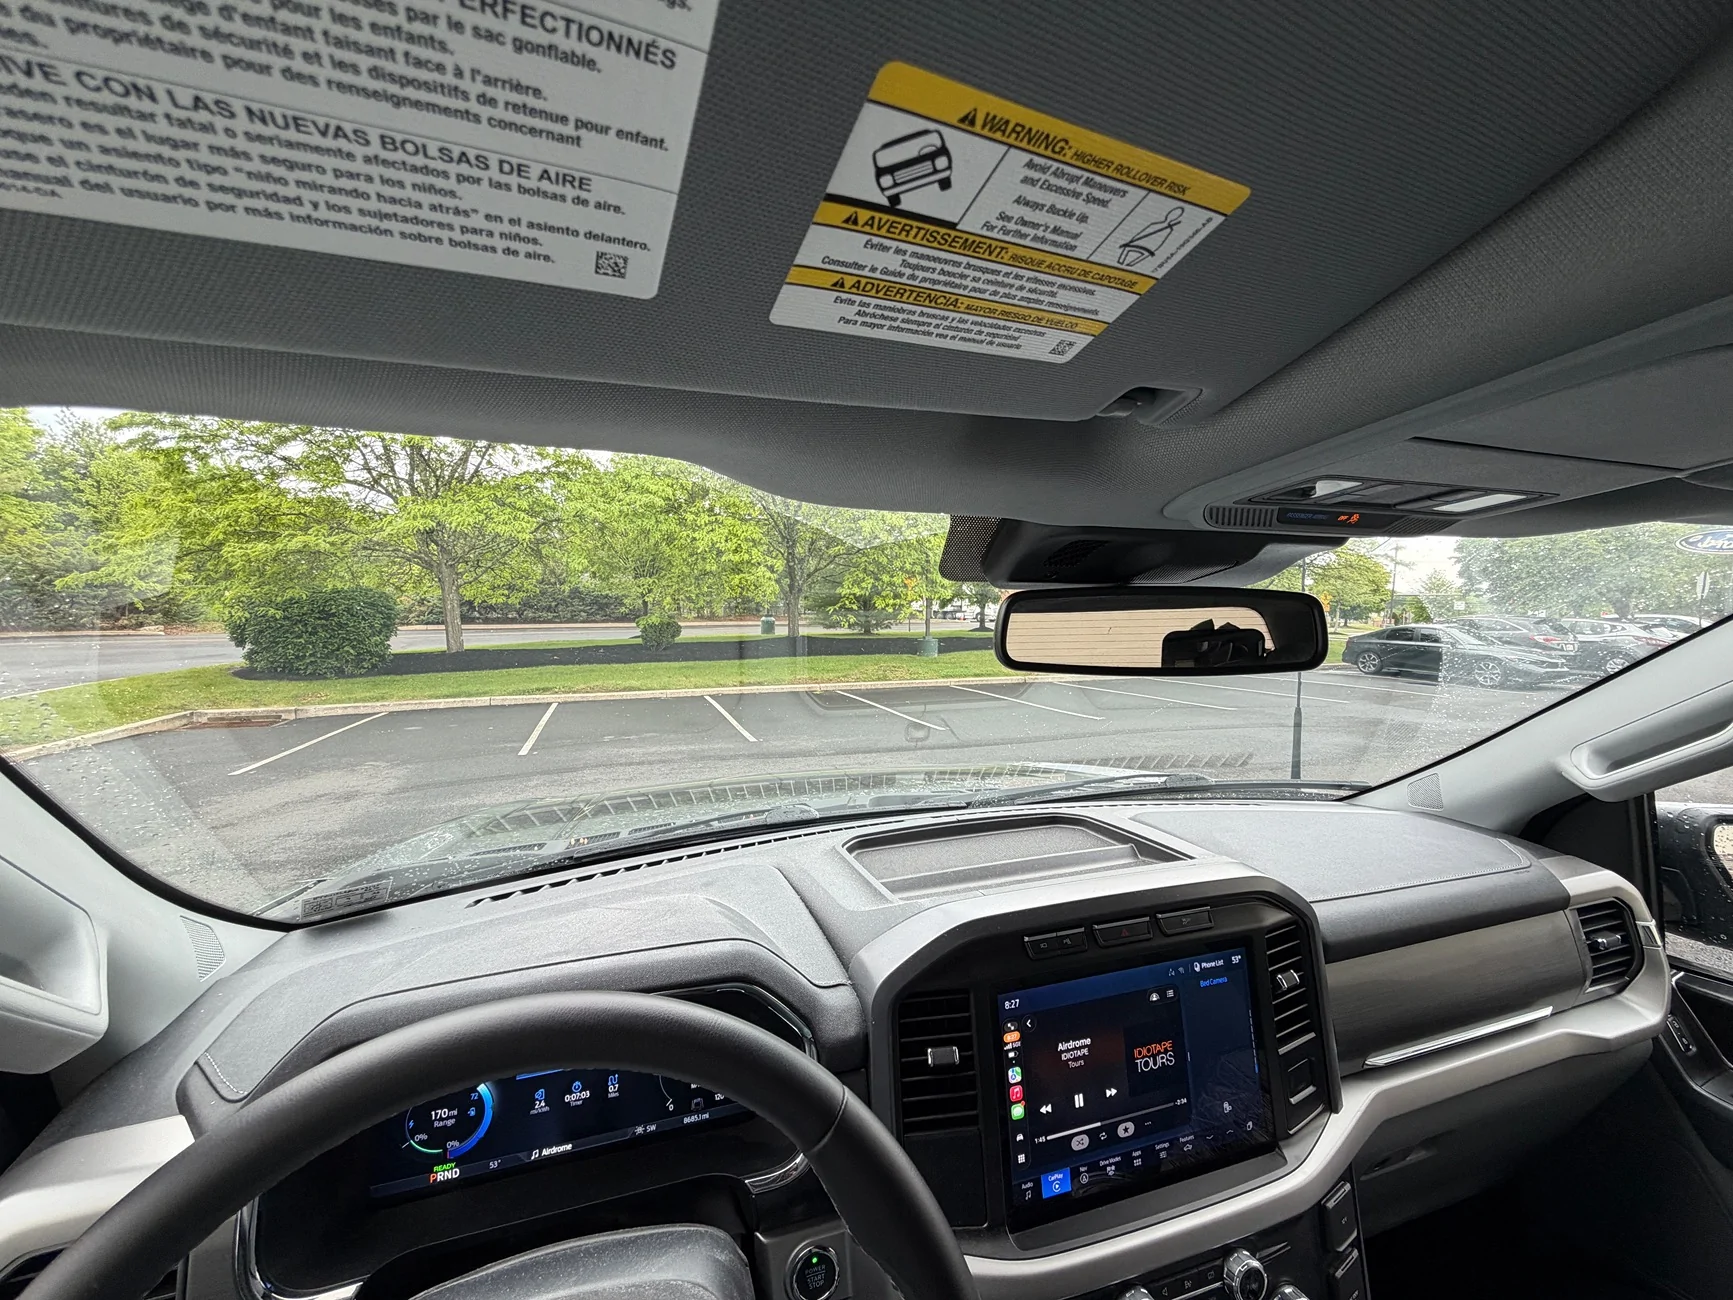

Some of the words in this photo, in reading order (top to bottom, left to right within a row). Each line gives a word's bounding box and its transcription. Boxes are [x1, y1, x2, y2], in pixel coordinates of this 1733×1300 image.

[404, 6, 440, 27] par
[446, 14, 465, 35] le
[471, 25, 506, 46] sac
[512, 37, 601, 73] gonflable.
[459, 0, 676, 69] ERFECTIONNÉS
[322, 29, 396, 63] faisant
[403, 50, 446, 76] face
[452, 63, 465, 80] à
[470, 68, 547, 101] l'arrière.
[328, 54, 362, 76] les
[367, 65, 470, 102] dispositifs
[476, 92, 498, 109] de
[504, 100, 569, 126] retenue
[574, 118, 611, 136] pour
[615, 129, 668, 151] enfant.
[74, 70, 159, 104] CON
[166, 89, 237, 120] LAS
[244, 105, 371, 147] NUEVAS
[379, 134, 490, 171] BOLSAS
[498, 159, 531, 180] DE
[537, 168, 592, 193] AIRE
[981, 112, 1072, 157] WARNING:
[1070, 149, 1115, 172] HIGHER
[1111, 163, 1168, 188] ROLLOVER
[1164, 180, 1191, 196] RISK
[1022, 158, 1053, 175] Avoid
[1049, 166, 1084, 185] Abrupt
[332, 167, 375, 184] para
[378, 174, 406, 190] los
[411, 182, 462, 201] niños.
[362, 154, 450, 181] afectados
[455, 172, 484, 186] por
[488, 176, 513, 193] las
[517, 182, 567, 203] bolsas
[571, 194, 590, 208] de
[593, 200, 625, 215] aire.
[1019, 175, 1042, 188] and
[1039, 178, 1084, 200] Excessive
[1012, 194, 1047, 212] Always
[1045, 203, 1077, 220] Buckle
[324, 200, 353, 215] los
[357, 208, 455, 232] sujetadores
[459, 224, 495, 239] para
[498, 231, 543, 247] niños.
[375, 191, 423, 210] hacia
[484, 213, 504, 225] en
[507, 216, 522, 228] el
[526, 221, 580, 238] asiento
[583, 230, 650, 252] delantero.
[995, 210, 1015, 224] See
[1014, 215, 1051, 233] Owner's
[1048, 225, 1083, 241] Manual
[288, 211, 394, 238] información
[398, 231, 444, 246] sobre
[448, 237, 498, 254] bolsas
[502, 246, 520, 258] de
[524, 250, 555, 264] aire.
[980, 220, 999, 233] For
[996, 224, 1031, 241] Further
[1029, 233, 1078, 252] Information
[861, 215, 1008, 259] AVERTISSEMENT:
[1004, 253, 1047, 274] RISQUE
[1040, 261, 1080, 281] ACCRU
[1073, 268, 1093, 284] DE
[1086, 272, 1138, 294] CAPOTAGE
[821, 255, 868, 272] Consulter
[867, 264, 879, 274] le
[879, 266, 906, 279] Guide
[906, 272, 920, 282] du
[848, 279, 964, 309] ADVERTENCIA:
[960, 303, 999, 320] MAYOR
[993, 309, 1032, 325] RIESGO
[1026, 315, 1046, 328] DE
[1201, 960, 1216, 970] Phone
[1215, 959, 1225, 968] List
[1200, 980, 1210, 988] Bed
[1209, 976, 1228, 986] Camera
[1004, 998, 1020, 1010] 8:27
[1057, 1037, 1091, 1052] Airdrome
[1133, 1040, 1174, 1059] IDIOTAPE
[1061, 1047, 1090, 1060] IDIOTAPE
[1068, 1059, 1085, 1069] Tours
[1135, 1051, 1176, 1073] TOURS
[608, 1084, 619, 1093] 0.7
[470, 1093, 479, 1101] 72
[564, 1090, 590, 1102] 0:07:03
[534, 1100, 546, 1109] 2.4
[430, 1108, 449, 1120] 170
[448, 1108, 458, 1117] mi
[701, 1112, 710, 1120] mi
[433, 1118, 456, 1128] Range
[646, 1124, 657, 1133] SW
[414, 1133, 429, 1142] 0%
[1033, 1135, 1046, 1144] 1:45
[446, 1140, 460, 1149] 0%
[541, 1143, 573, 1157] Airdrome
[1154, 1142, 1170, 1151] Settings
[1132, 1149, 1142, 1158] Apps
[433, 1161, 457, 1173] READY
[1099, 1159, 1110, 1167] Drive
[429, 1168, 460, 1184] PRND
[1048, 1172, 1064, 1181] CarPlay
[1021, 1181, 1034, 1190] Audio
[804, 1264, 826, 1275] POWER
[807, 1273, 825, 1285] START
[809, 1280, 825, 1290] STOP
